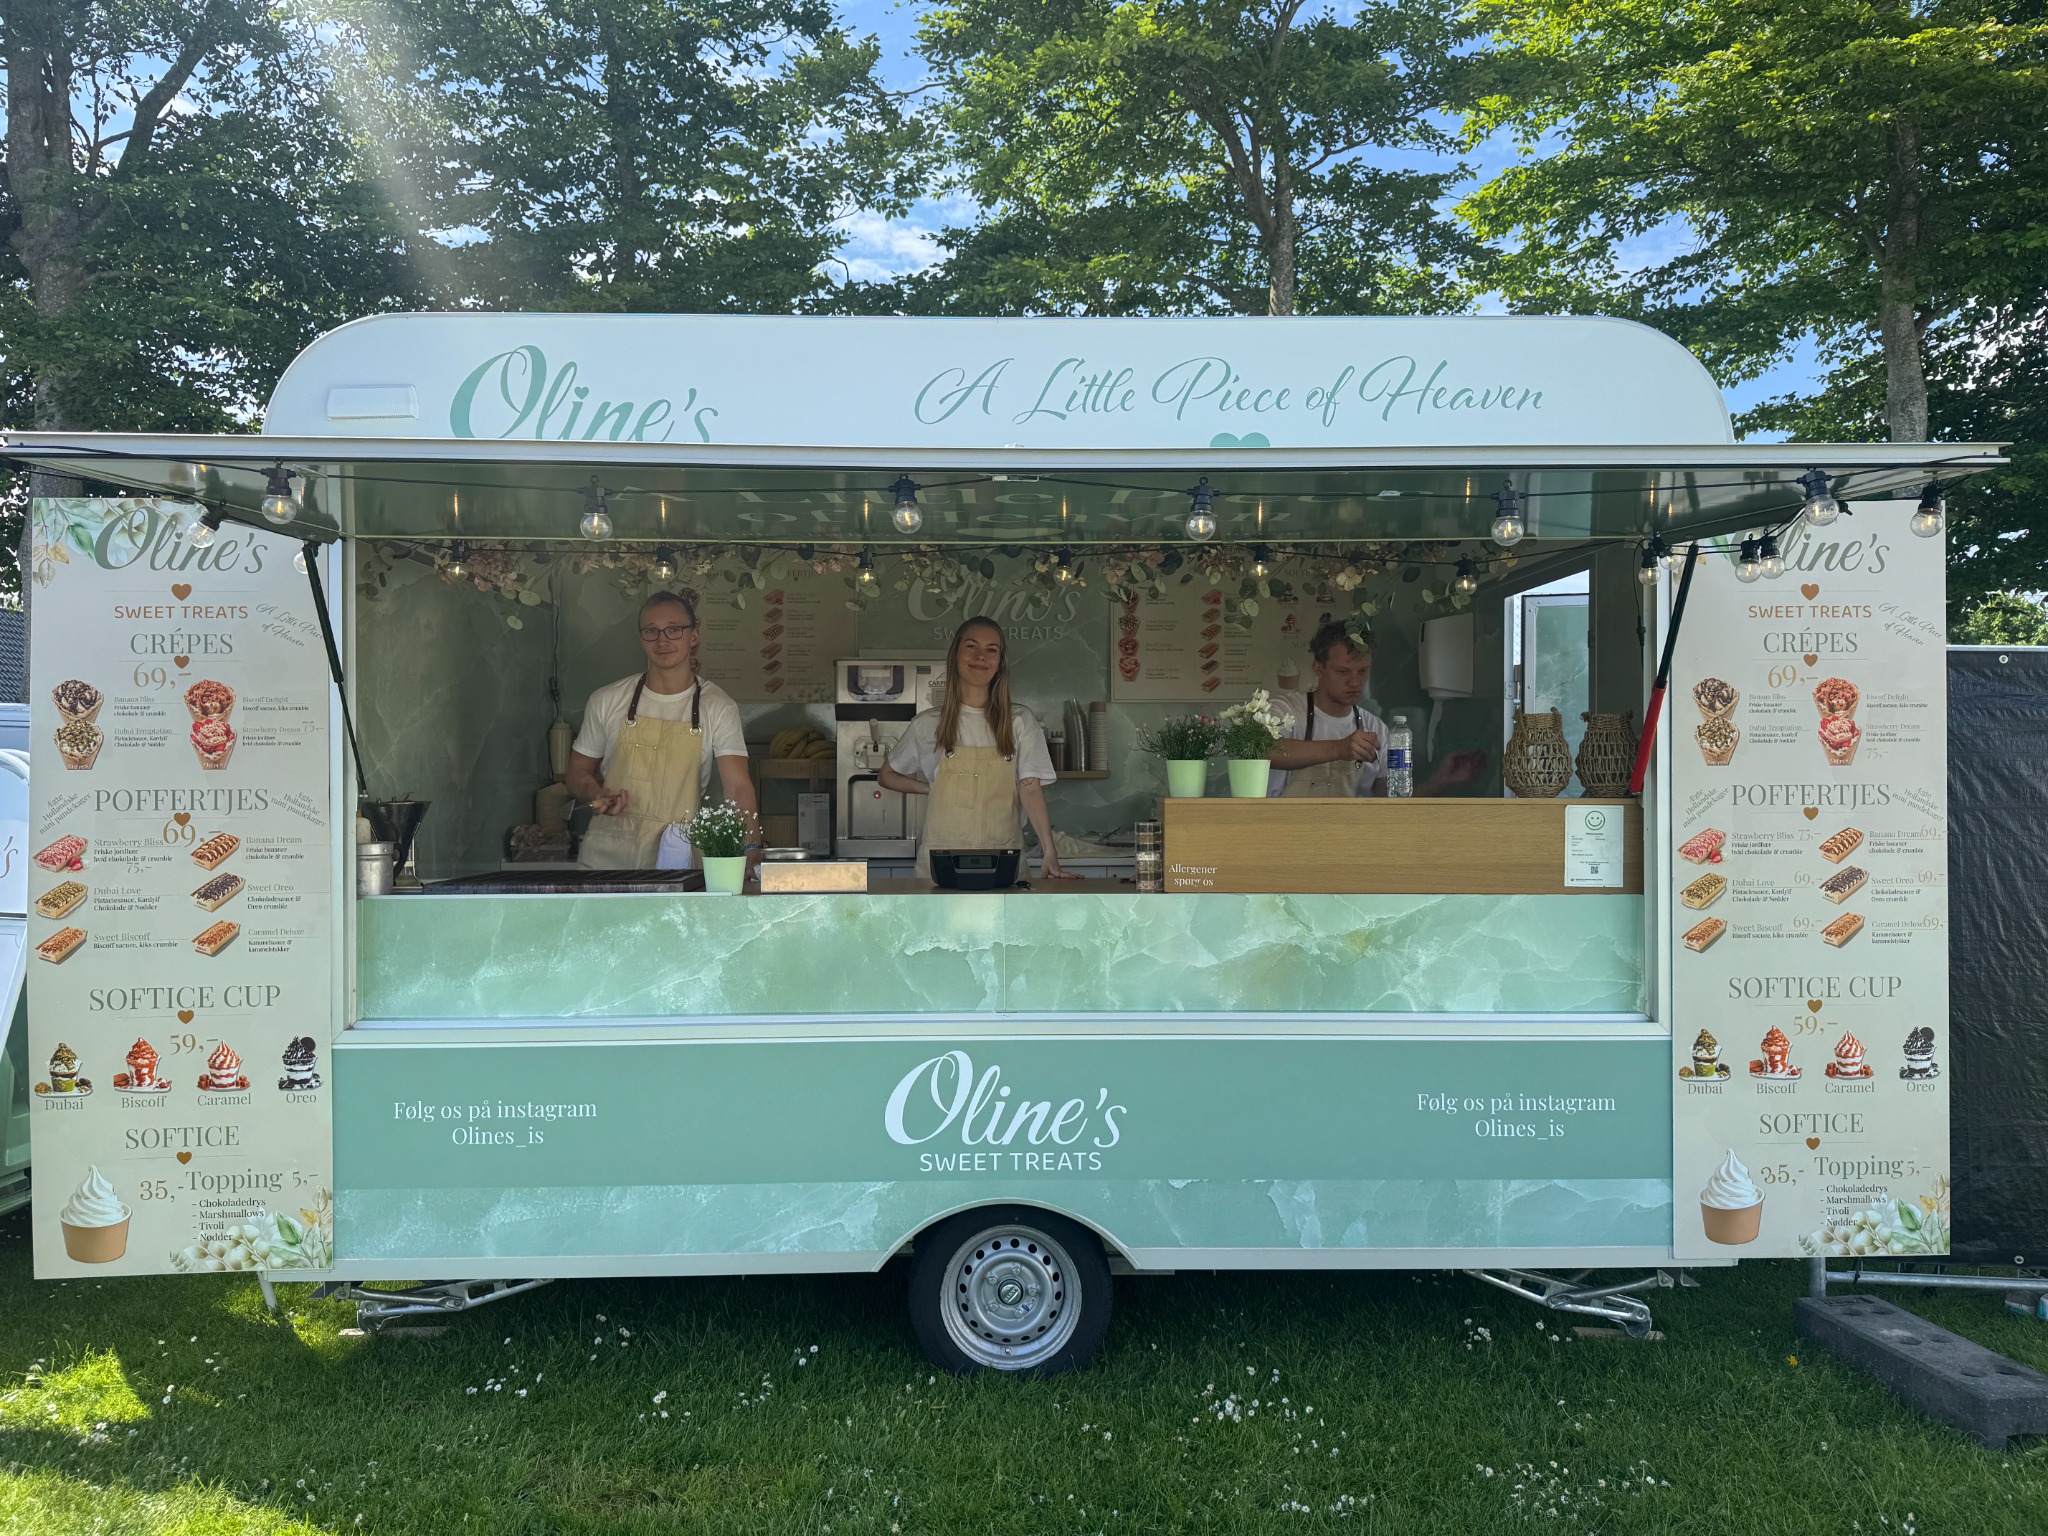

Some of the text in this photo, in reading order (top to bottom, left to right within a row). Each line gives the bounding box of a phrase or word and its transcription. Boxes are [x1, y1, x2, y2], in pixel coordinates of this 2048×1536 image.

[450, 344, 718, 443] Oline's
[913, 355, 1543, 429] A Little Piece of Heaven
[94, 505, 268, 574] Oline's
[1728, 522, 1890, 574] line's
[114, 605, 249, 619] SWEET TREATS
[1748, 605, 1872, 619] SWEET TREATS
[130, 628, 233, 655] CRÉPES
[1763, 627, 1858, 653] CRÉPES
[94, 789, 269, 815] POFFERTJES
[1731, 784, 1890, 810] POFFERTJES
[39, 792, 91, 835] mini pandekager
[287, 805, 327, 827] pandekager
[94, 838, 164, 847] Strawberry Bliss
[246, 836, 302, 844] Banana Dream
[1732, 832, 1795, 842] Strawberry Bliss
[1168, 863, 1218, 875] Allergener
[94, 887, 142, 895] Dubai Love
[247, 884, 294, 892] Sweet Oreo
[1732, 879, 1775, 887] Dubai Love
[94, 932, 151, 941] Sweet Biscoff
[280, 928, 304, 936] Deluxe
[1728, 975, 1902, 1000] SOFTICE CUP
[89, 985, 281, 1012] SOFTICE CUP
[1688, 1081, 1935, 1095] Dubai Biscoff Caramel Oreo
[45, 1092, 317, 1111] Dubai Biscoff Caramel Oreo
[884, 1050, 1127, 1149] Oline's
[1417, 1092, 1616, 1115] Følg os på instagram
[393, 1099, 598, 1123] Følg os på instagram
[1475, 1119, 1564, 1140] Olines_is
[1759, 1112, 1864, 1135] SOFTICE
[125, 1125, 240, 1150] SOFTICE
[452, 1125, 544, 1147] Olines_is
[919, 1151, 1102, 1172] SWEET TREATS
[1814, 1155, 1903, 1179] Topping
[186, 1168, 283, 1193] Topping
[1826, 1184, 1888, 1194] Chokoladedrys
[199, 1198, 266, 1209] Chokoladedrys
[1826, 1195, 1887, 1204] Marshmallows
[199, 1210, 264, 1219] Marshmallows
[1826, 1206, 1849, 1215] Tivoli
[199, 1221, 224, 1230] Tivoli
[1826, 1218, 1858, 1227] Nødder
[200, 1232, 233, 1242] Nødder
